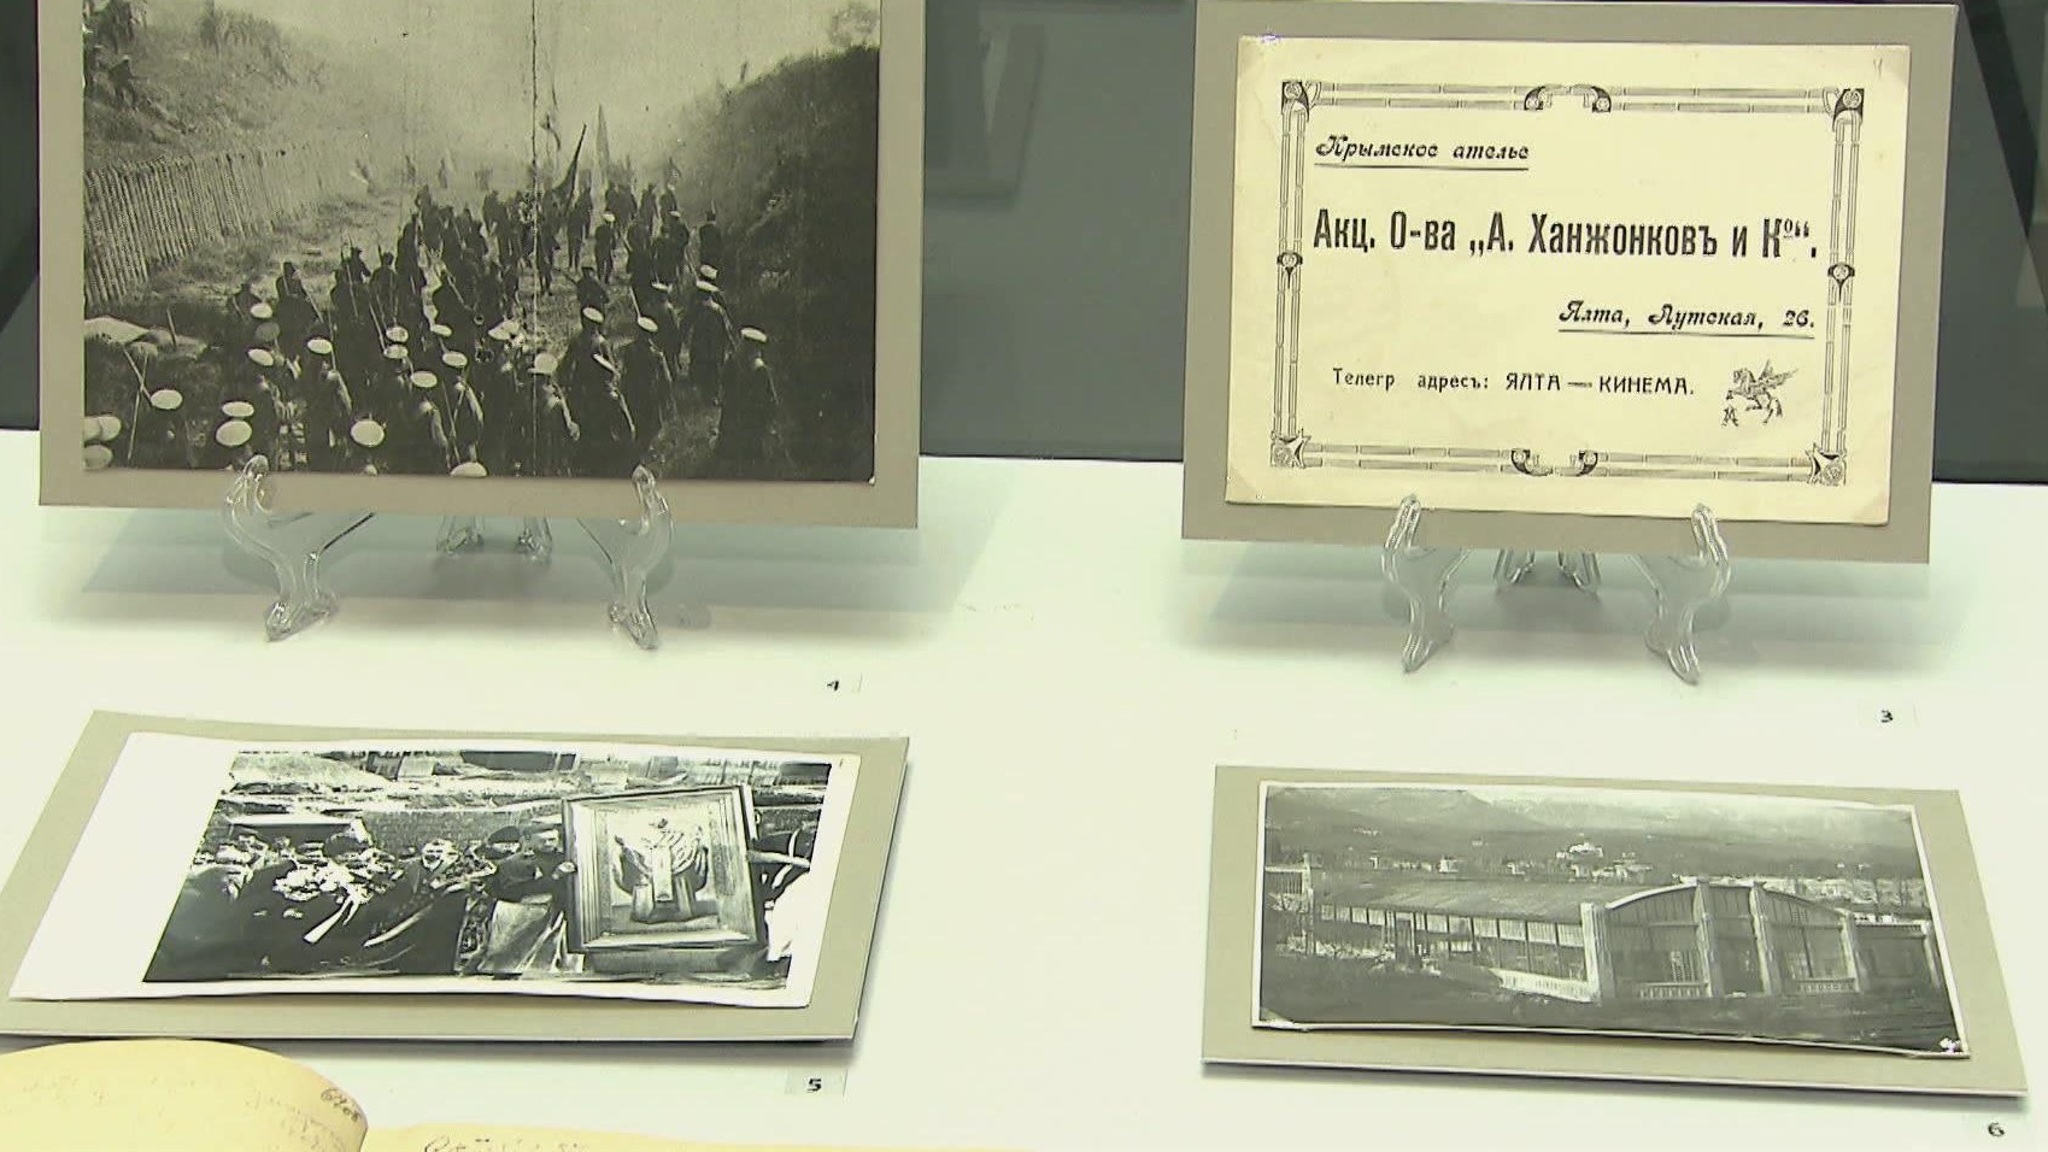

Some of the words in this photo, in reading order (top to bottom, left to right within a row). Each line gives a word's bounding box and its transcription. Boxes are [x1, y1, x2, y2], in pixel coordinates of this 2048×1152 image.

[1315, 134, 1439, 163] Крымское
[1452, 145, 1530, 160] ателье
[1313, 207, 1376, 254] Акц.
[1390, 210, 1456, 252] О-ва
[1527, 213, 1718, 257] Ханжонковъ
[1731, 225, 1748, 258] и
[1558, 300, 1631, 328] Ялта,
[1647, 304, 1764, 332] Лутская,
[1782, 309, 1815, 329] 26.
[1332, 367, 1396, 392] Телегр
[1417, 374, 1489, 394] адресъ:
[1505, 372, 1561, 392] ЯЛТА
[1599, 375, 1694, 396] КИНЕМА.
[1880, 709, 1894, 724] 3
[807, 1078, 822, 1092] 5
[1987, 1122, 2006, 1138] 6
